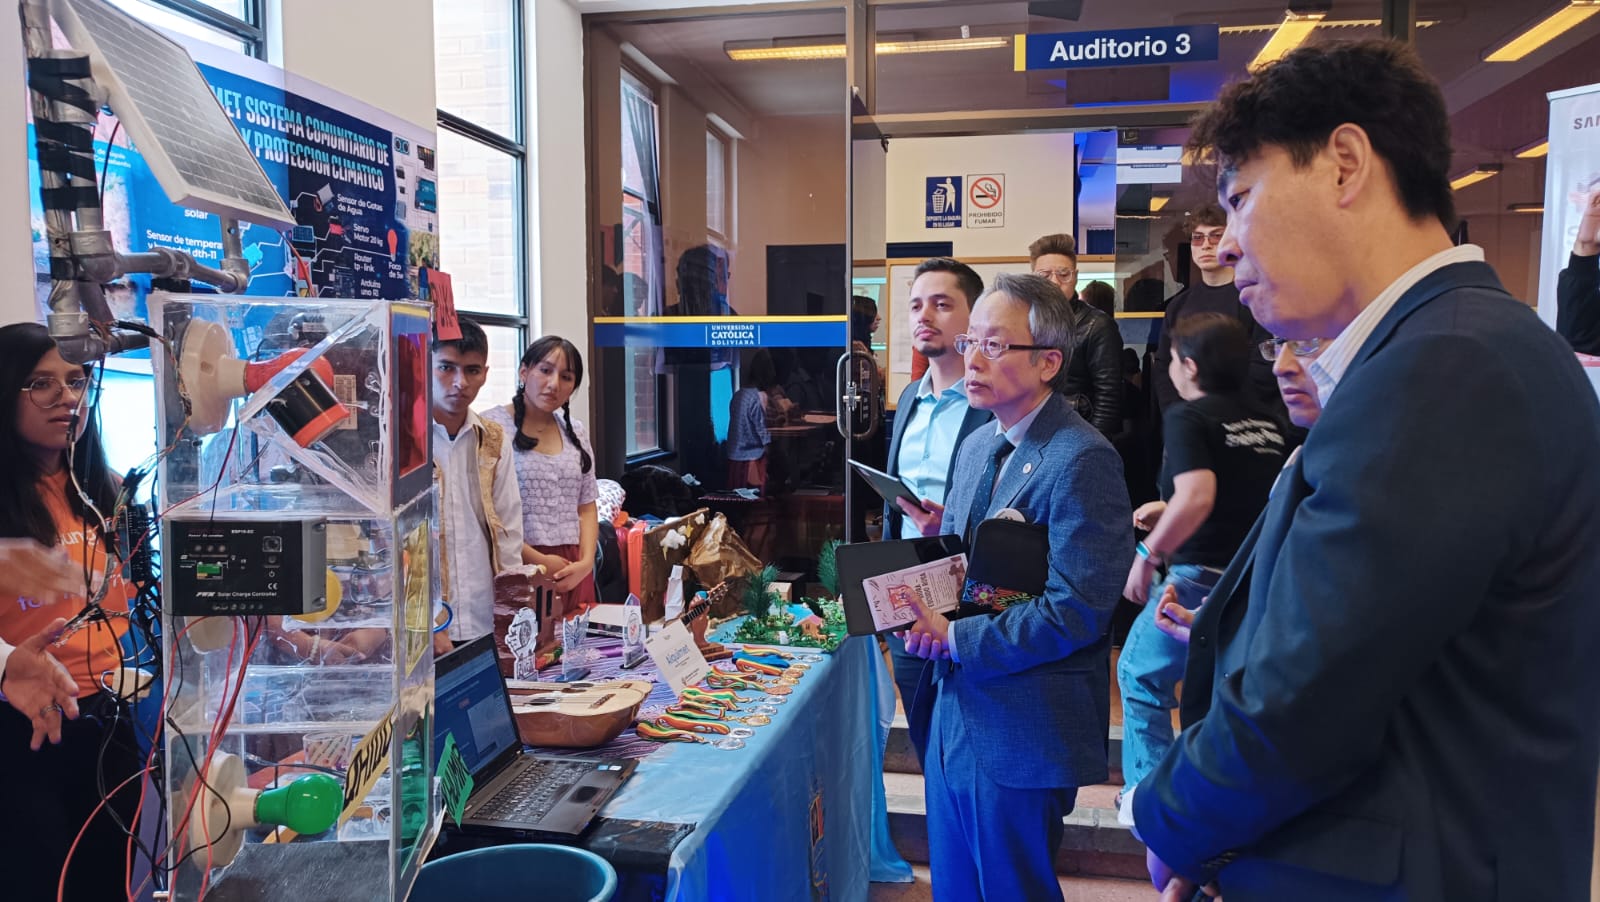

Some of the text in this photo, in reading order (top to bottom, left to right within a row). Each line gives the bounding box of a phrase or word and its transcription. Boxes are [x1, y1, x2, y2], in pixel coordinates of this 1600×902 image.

[1049, 33, 1191, 62] Auditorio 3
[244, 95, 304, 139] SISTEMA
[305, 114, 377, 162] COMUNITARIO
[377, 142, 390, 166] DE
[254, 130, 331, 176] PROTECCION
[331, 156, 385, 192] CLIMATICO
[336, 194, 383, 212] Sensor de Gotas
[184, 208, 208, 220] solar
[337, 204, 363, 216] de Agua
[353, 223, 370, 234] Servo
[146, 230, 172, 242] Sensor
[173, 233, 185, 245] de
[192, 248, 217, 259] dth-11
[354, 253, 372, 263] Router
[388, 262, 402, 271] Foco
[711, 330, 754, 339] CATÓLICA
